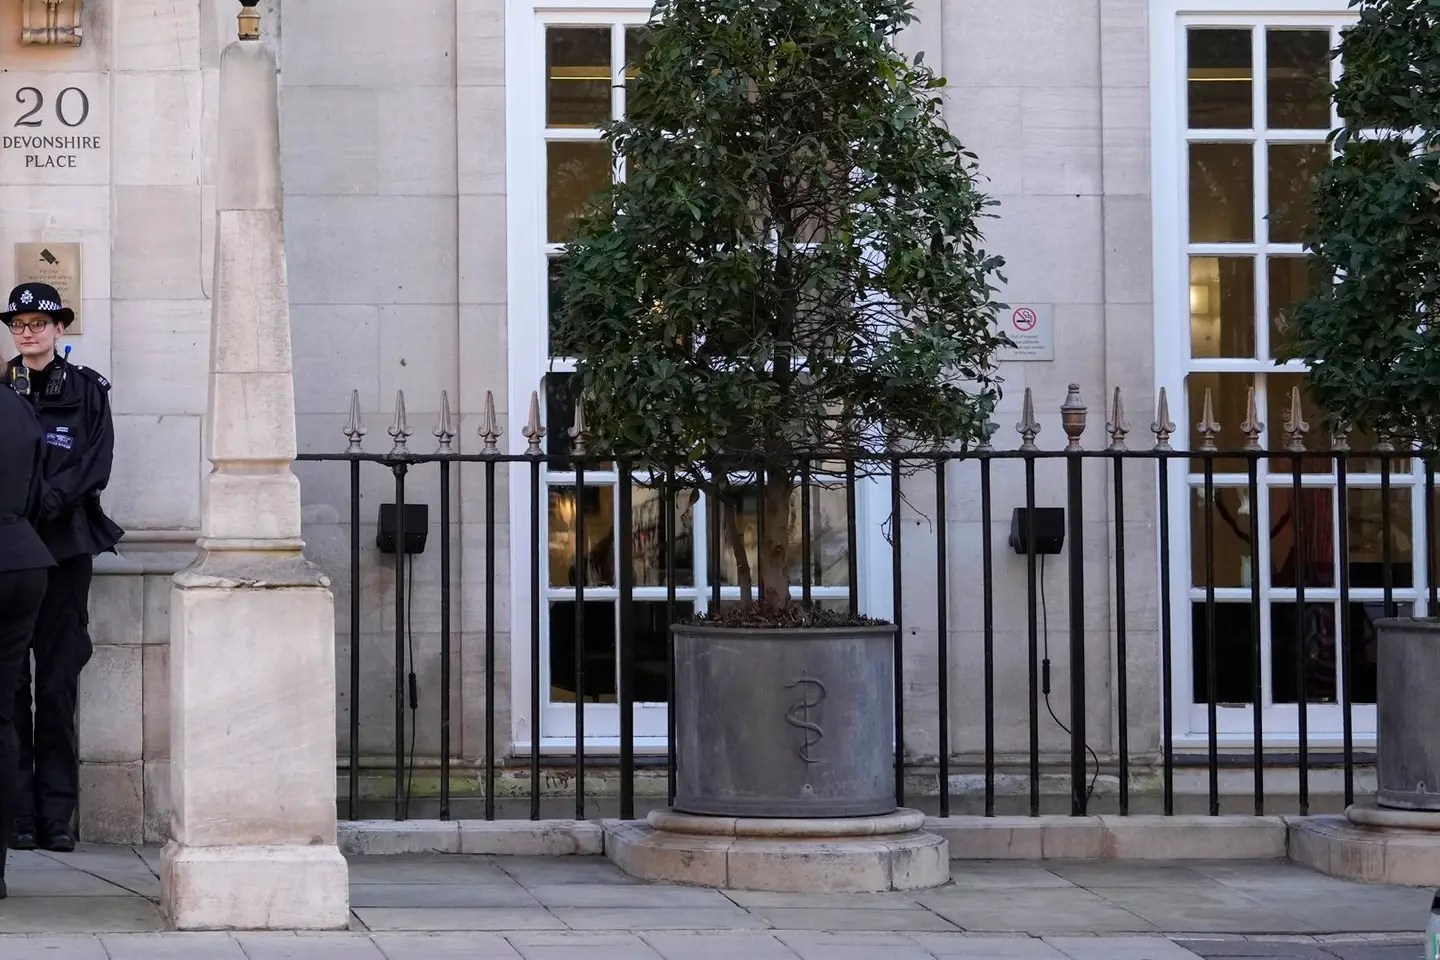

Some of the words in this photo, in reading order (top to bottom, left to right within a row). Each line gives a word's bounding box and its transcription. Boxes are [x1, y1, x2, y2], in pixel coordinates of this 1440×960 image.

[13, 86, 90, 128] 20
[2, 136, 101, 149] DEVONSHIRE
[25, 155, 77, 168] PLACE
